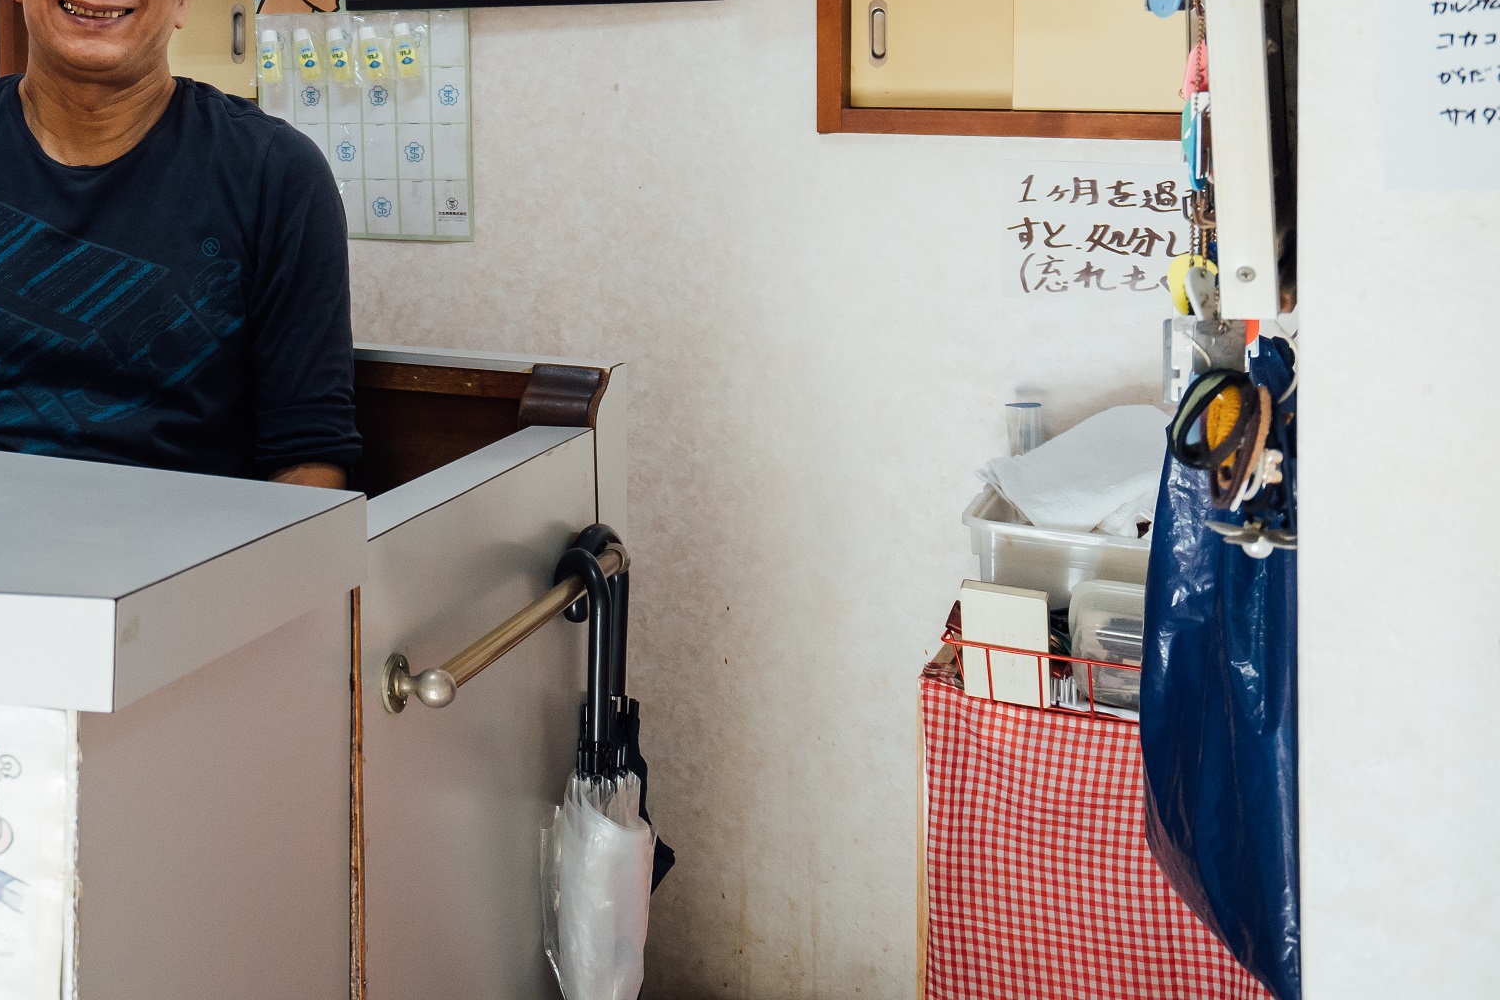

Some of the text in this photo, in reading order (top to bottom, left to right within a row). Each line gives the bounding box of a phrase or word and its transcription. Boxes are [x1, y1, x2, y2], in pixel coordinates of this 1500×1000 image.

[1018, 174, 1193, 213] 1ヶ月を過
[1019, 252, 1170, 294] (忘れも
